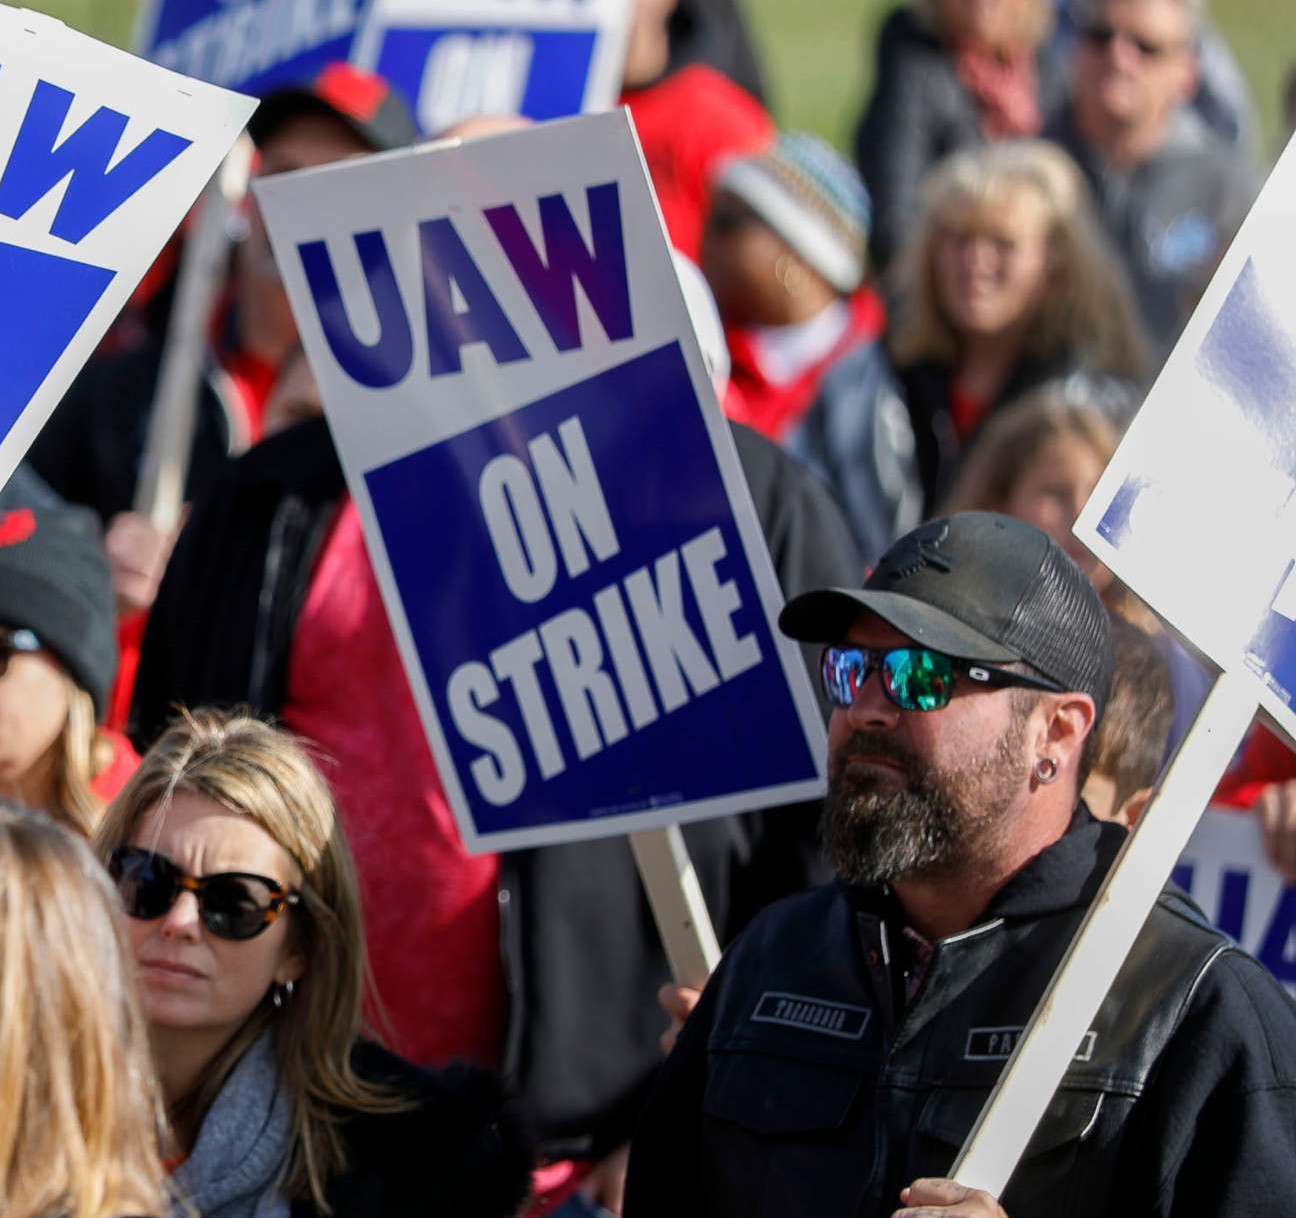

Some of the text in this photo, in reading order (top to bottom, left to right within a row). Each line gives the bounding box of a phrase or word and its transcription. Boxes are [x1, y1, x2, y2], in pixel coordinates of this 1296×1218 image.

[297, 181, 634, 391] UAW
[478, 415, 620, 603] ON
[446, 526, 763, 807] STRIKE
